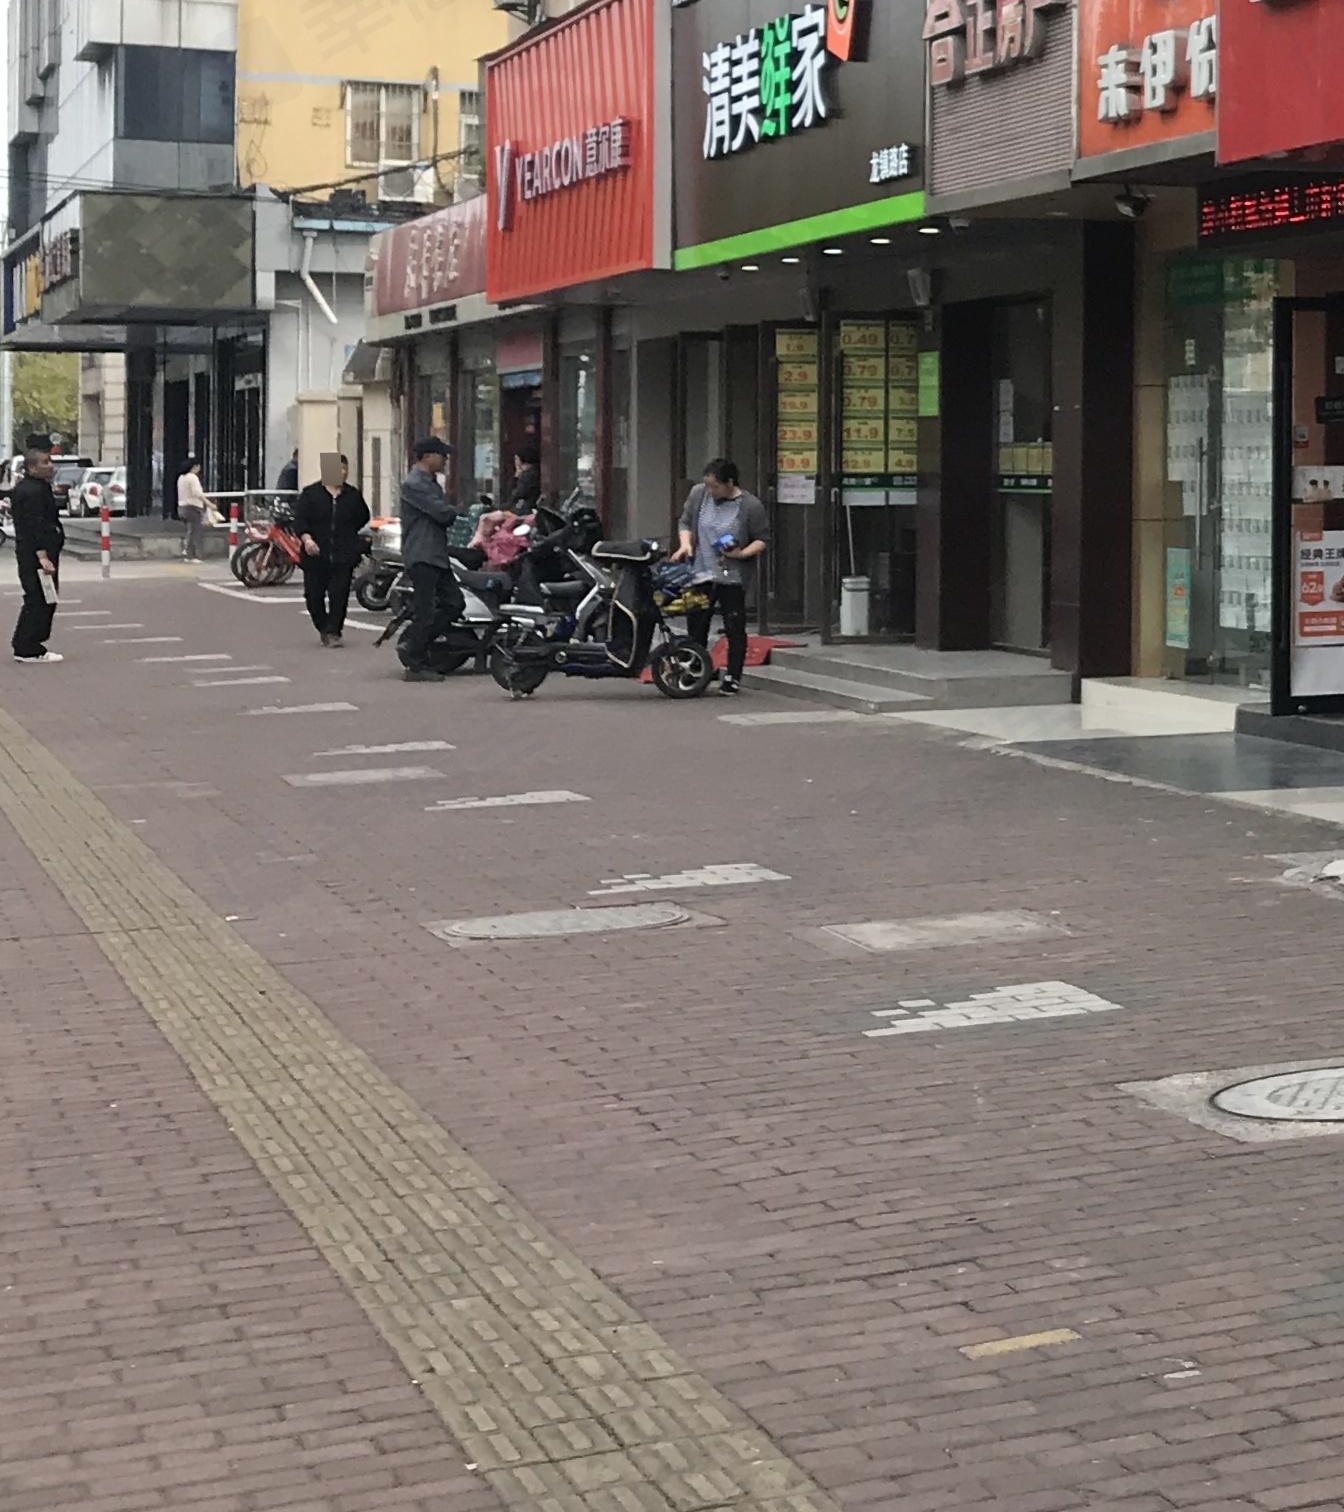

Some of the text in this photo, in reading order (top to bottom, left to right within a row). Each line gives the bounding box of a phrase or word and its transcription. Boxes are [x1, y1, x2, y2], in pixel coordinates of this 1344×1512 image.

[703, 4, 826, 160] 清美鲜家
[1097, 15, 1216, 120] 来伊份
[515, 136, 584, 201] YEARCON
[585, 116, 628, 177] 意尔康
